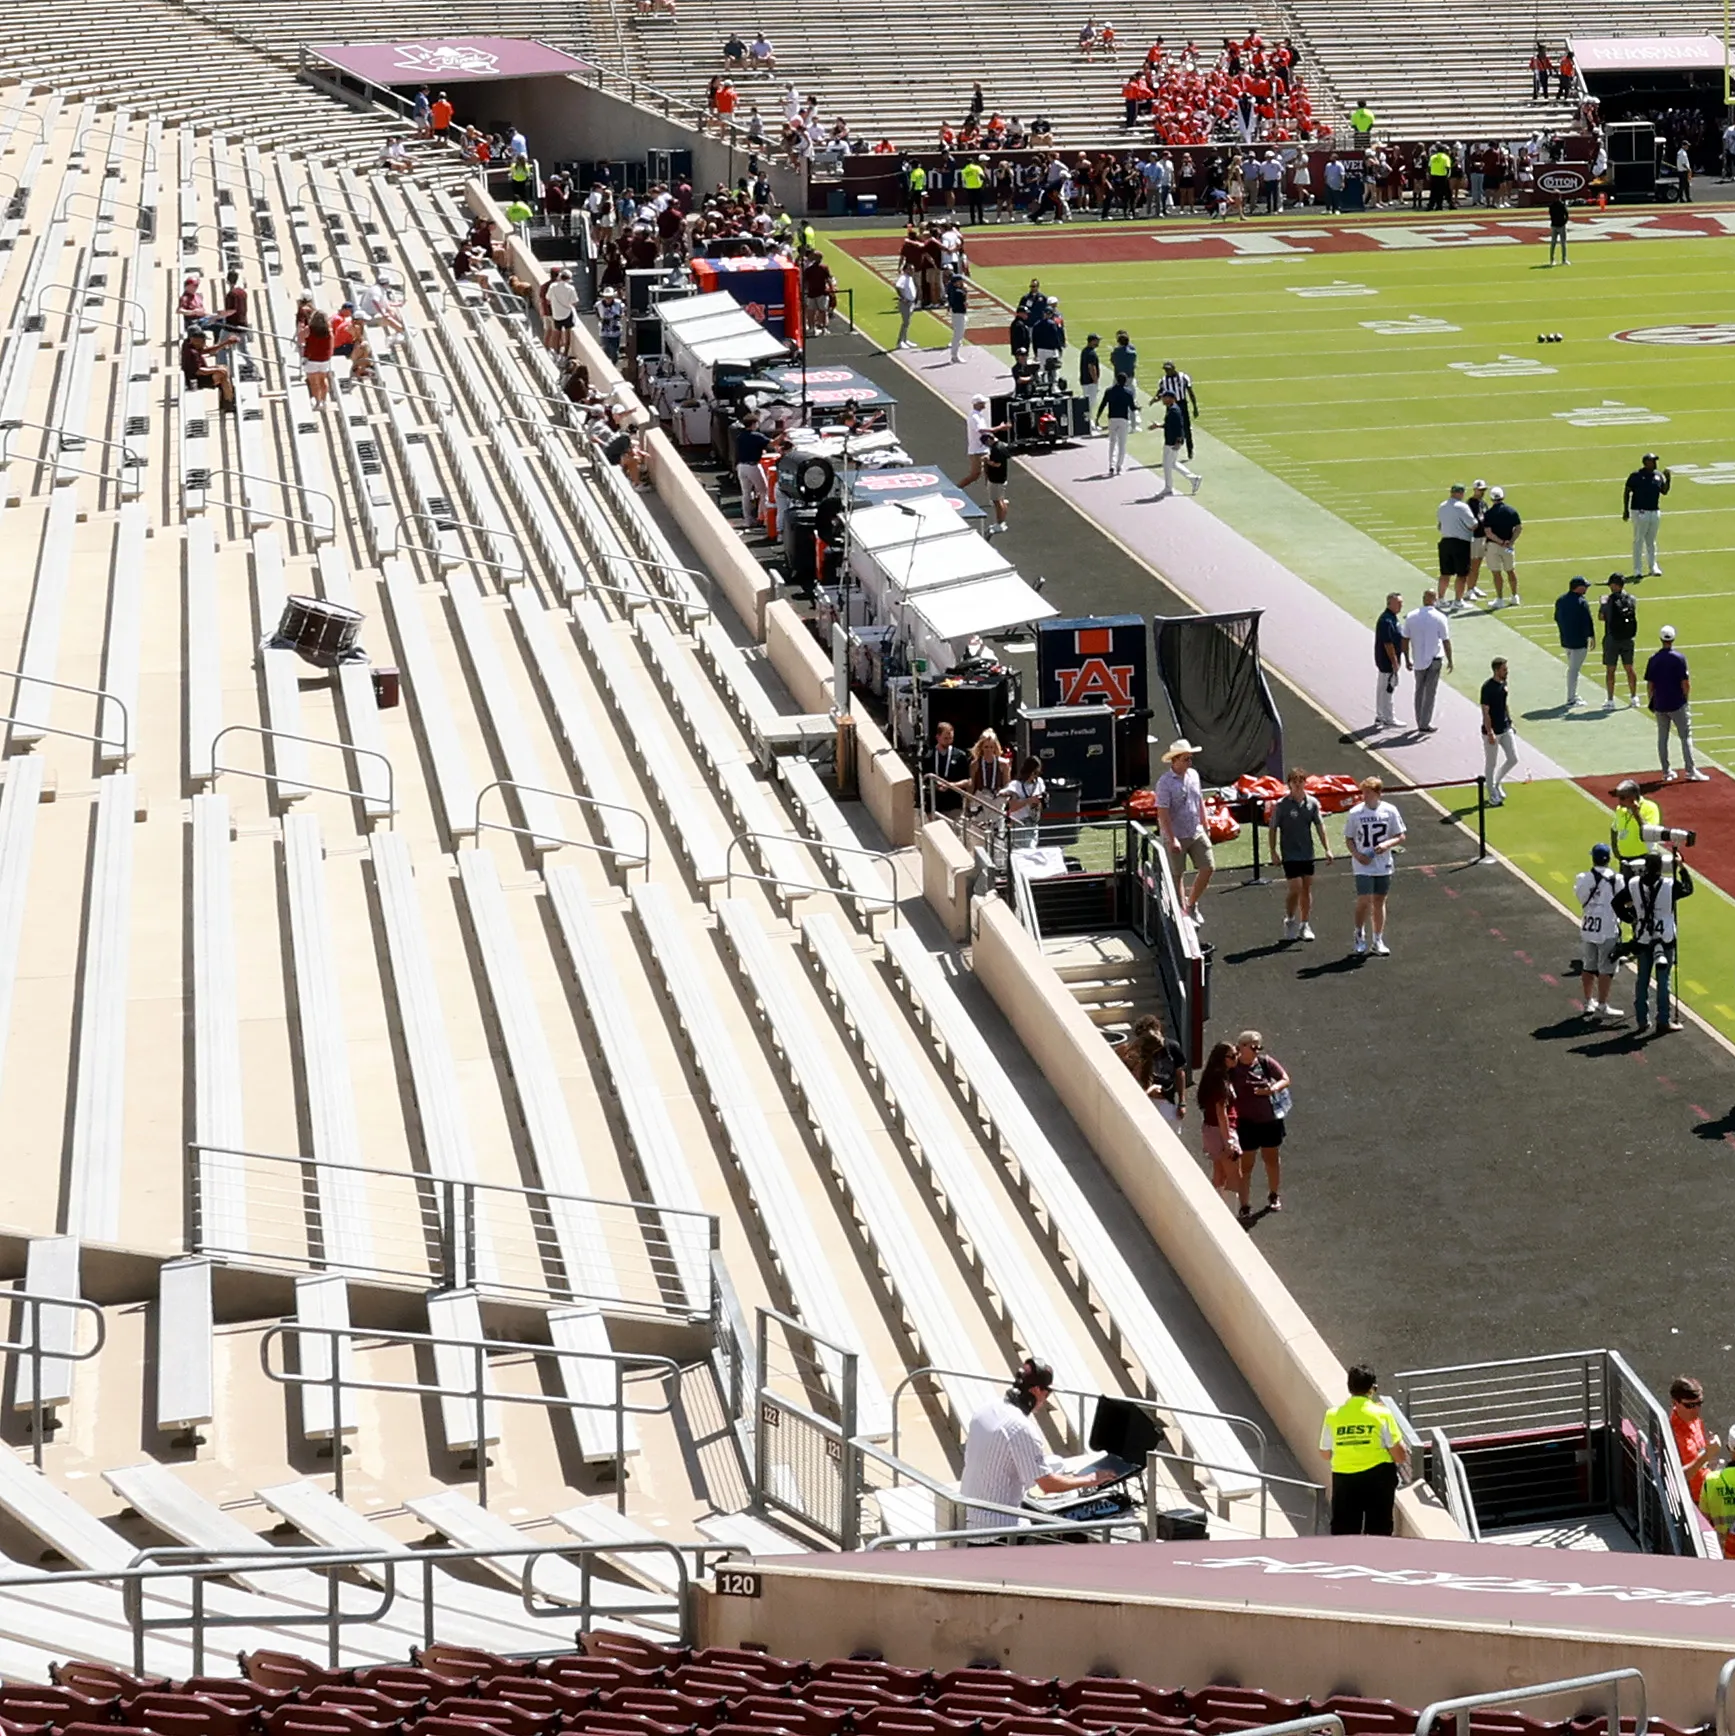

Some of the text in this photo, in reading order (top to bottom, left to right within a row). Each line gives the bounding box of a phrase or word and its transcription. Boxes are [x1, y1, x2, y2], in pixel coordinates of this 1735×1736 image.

[1362, 823, 1388, 848] 12
[1336, 1424, 1376, 1437] BEST
[721, 1573, 755, 1596] 120
